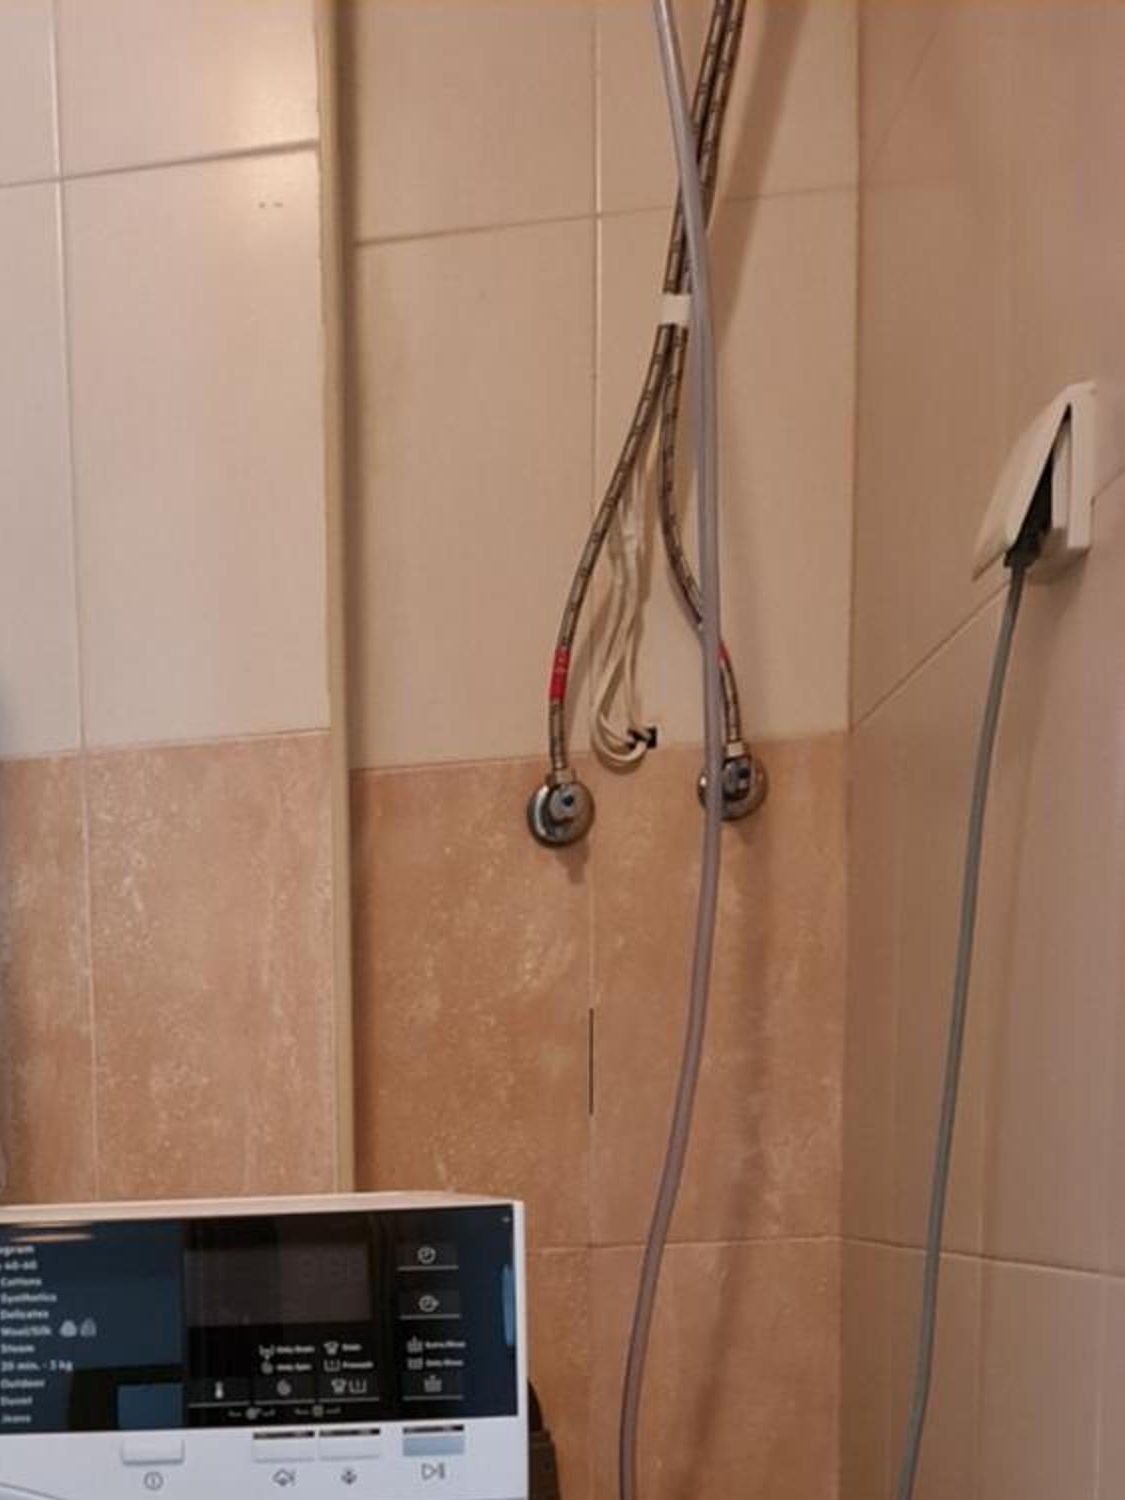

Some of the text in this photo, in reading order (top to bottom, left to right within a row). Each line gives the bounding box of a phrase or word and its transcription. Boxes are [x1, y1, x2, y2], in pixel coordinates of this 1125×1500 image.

[0, 1276, 43, 1288] Cottons
[0, 1292, 58, 1305] Synthetics
[0, 1309, 50, 1321] Delicates
[0, 1343, 35, 1354] Steam
[0, 1378, 46, 1390] Outdoor
